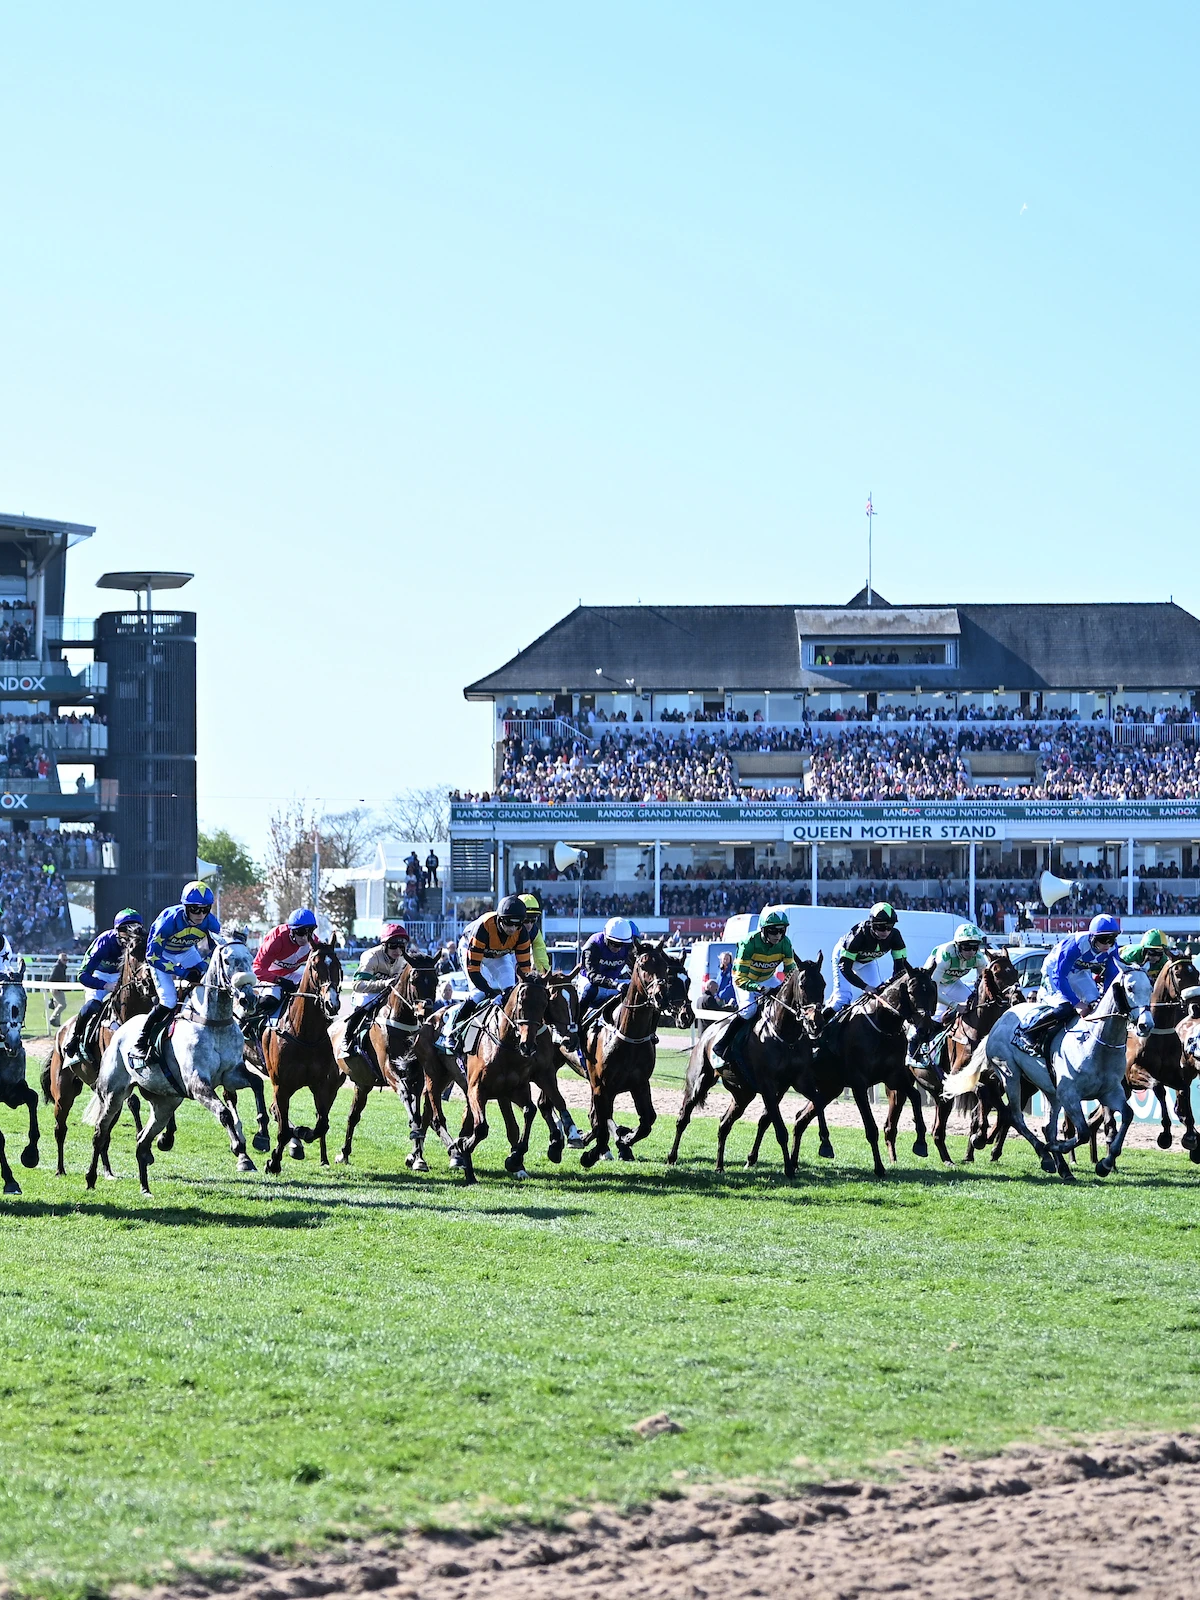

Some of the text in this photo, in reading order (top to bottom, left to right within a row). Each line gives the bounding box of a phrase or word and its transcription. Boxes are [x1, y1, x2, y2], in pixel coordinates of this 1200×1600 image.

[456, 810, 579, 819] RANDOX GRAND NATIONAL
[598, 809, 721, 818] RANDOX GRAND NATIONAL
[740, 809, 864, 818] RANDOX GRAND NATIONAL
[883, 808, 1006, 817] RANDOX GRAND NATIONAL
[1025, 808, 1063, 817] RANDOX
[1104, 808, 1151, 817] NATIONAL
[1159, 807, 1197, 816] RANDOX
[793, 825, 996, 841] QUEEN MOTHER STAND
